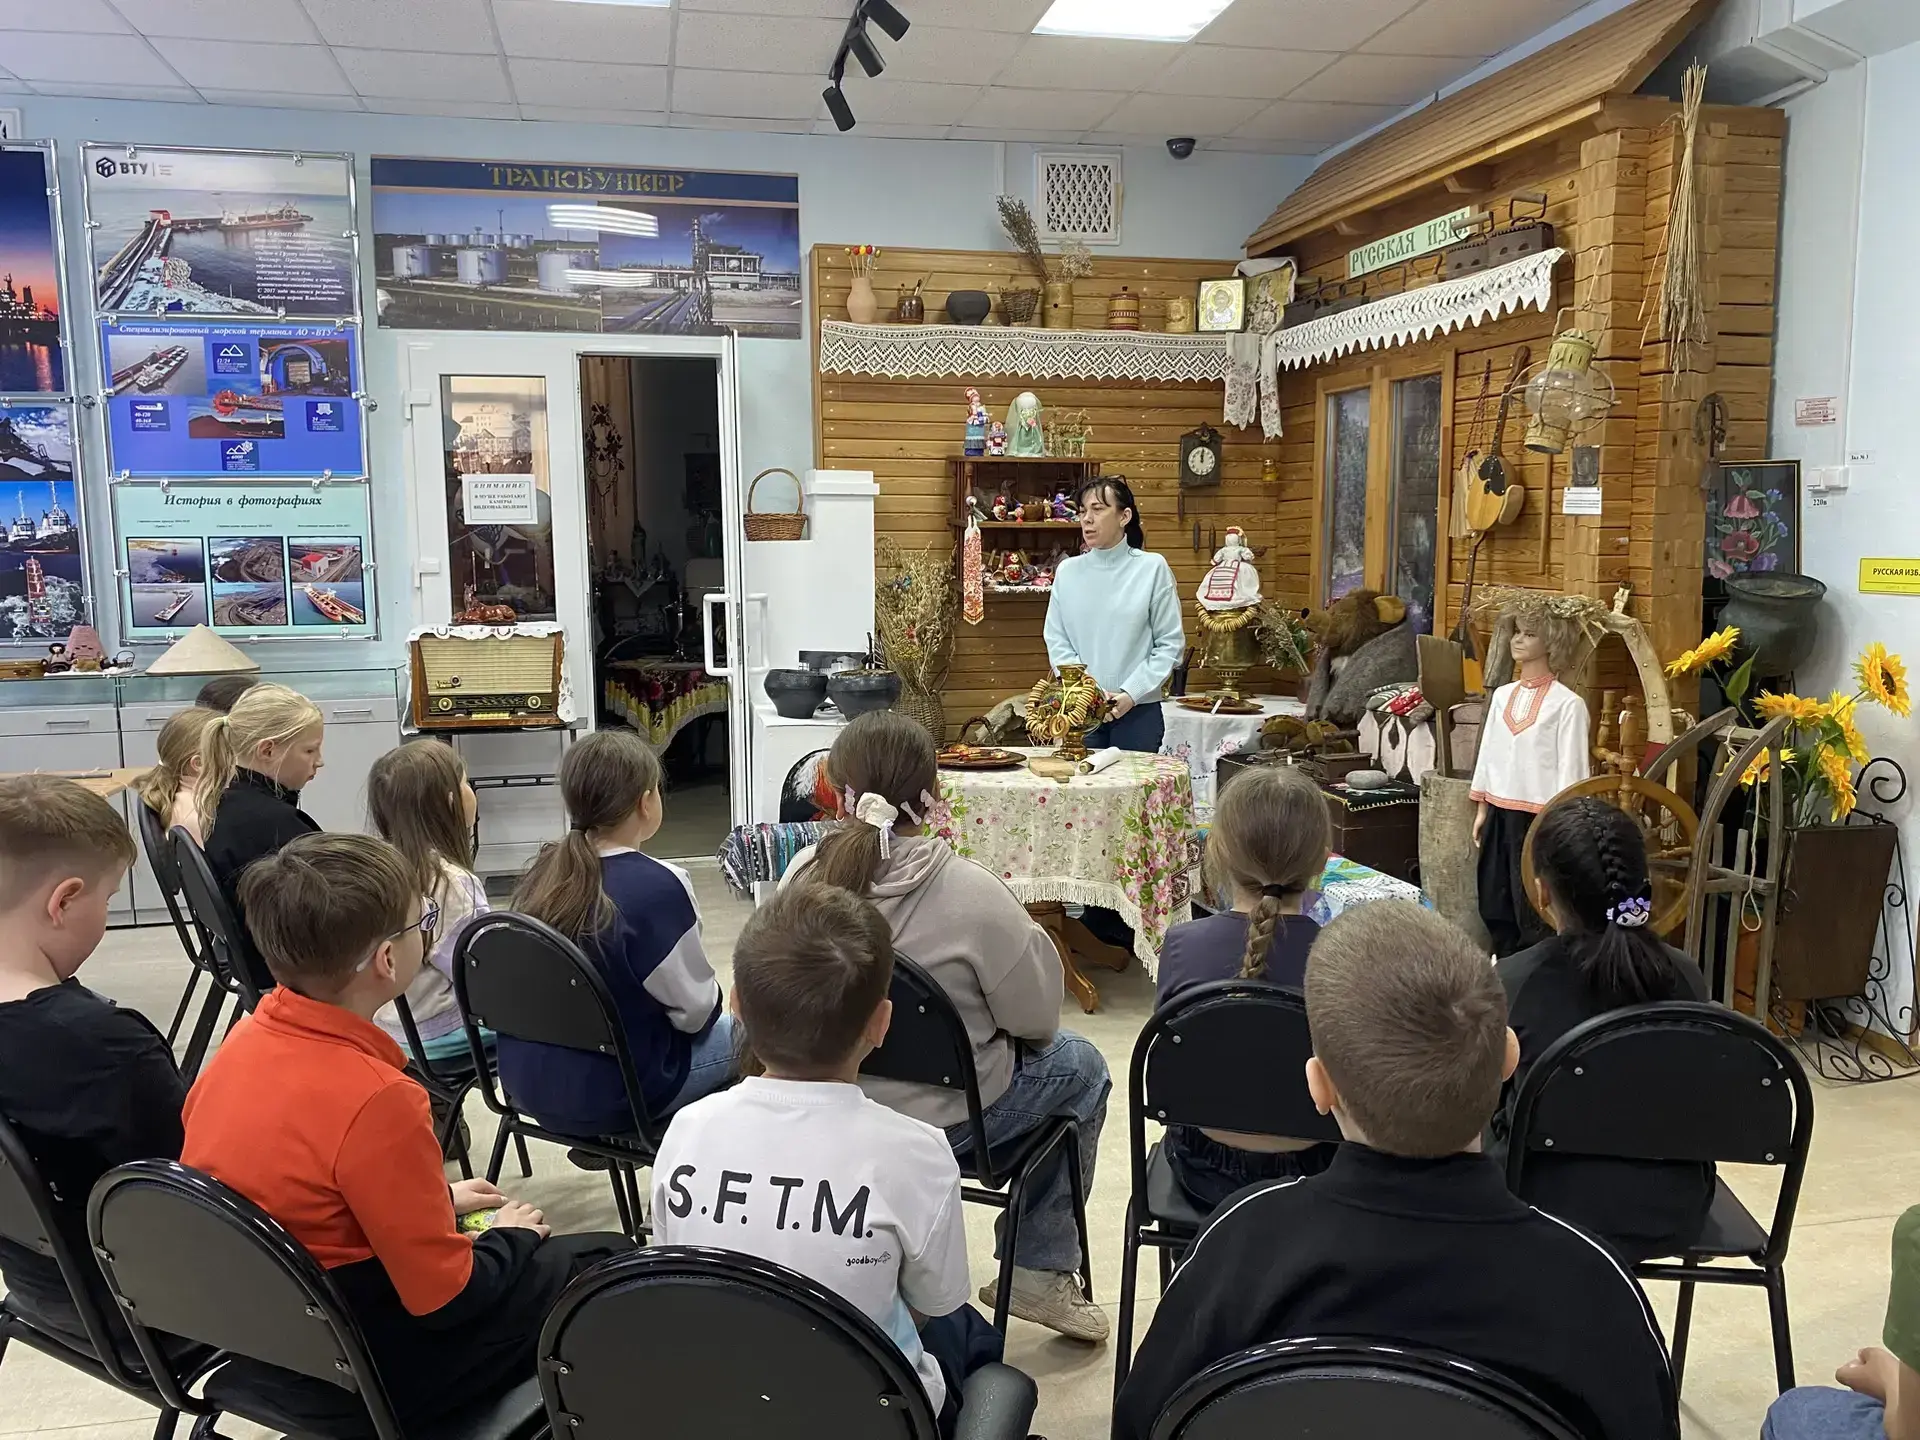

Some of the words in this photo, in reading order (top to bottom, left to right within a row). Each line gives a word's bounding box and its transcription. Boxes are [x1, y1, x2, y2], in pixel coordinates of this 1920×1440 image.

[120, 162, 148, 175] ВТУ
[488, 166, 684, 193] ТРАНСБУНКЕР
[1352, 231, 1416, 274] РУССКАЯ
[119, 324, 209, 336] Специализированный
[212, 328, 247, 337] морской
[249, 329, 292, 337] терминал
[295, 328, 309, 336] АО
[164, 494, 221, 506] История
[226, 497, 233, 505] в
[238, 494, 322, 508] фотографиях
[1872, 567, 1904, 576] РУССКАЯ
[1904, 568, 1920, 577] ИЗБ
[845, 1254, 880, 1267] goodboy
